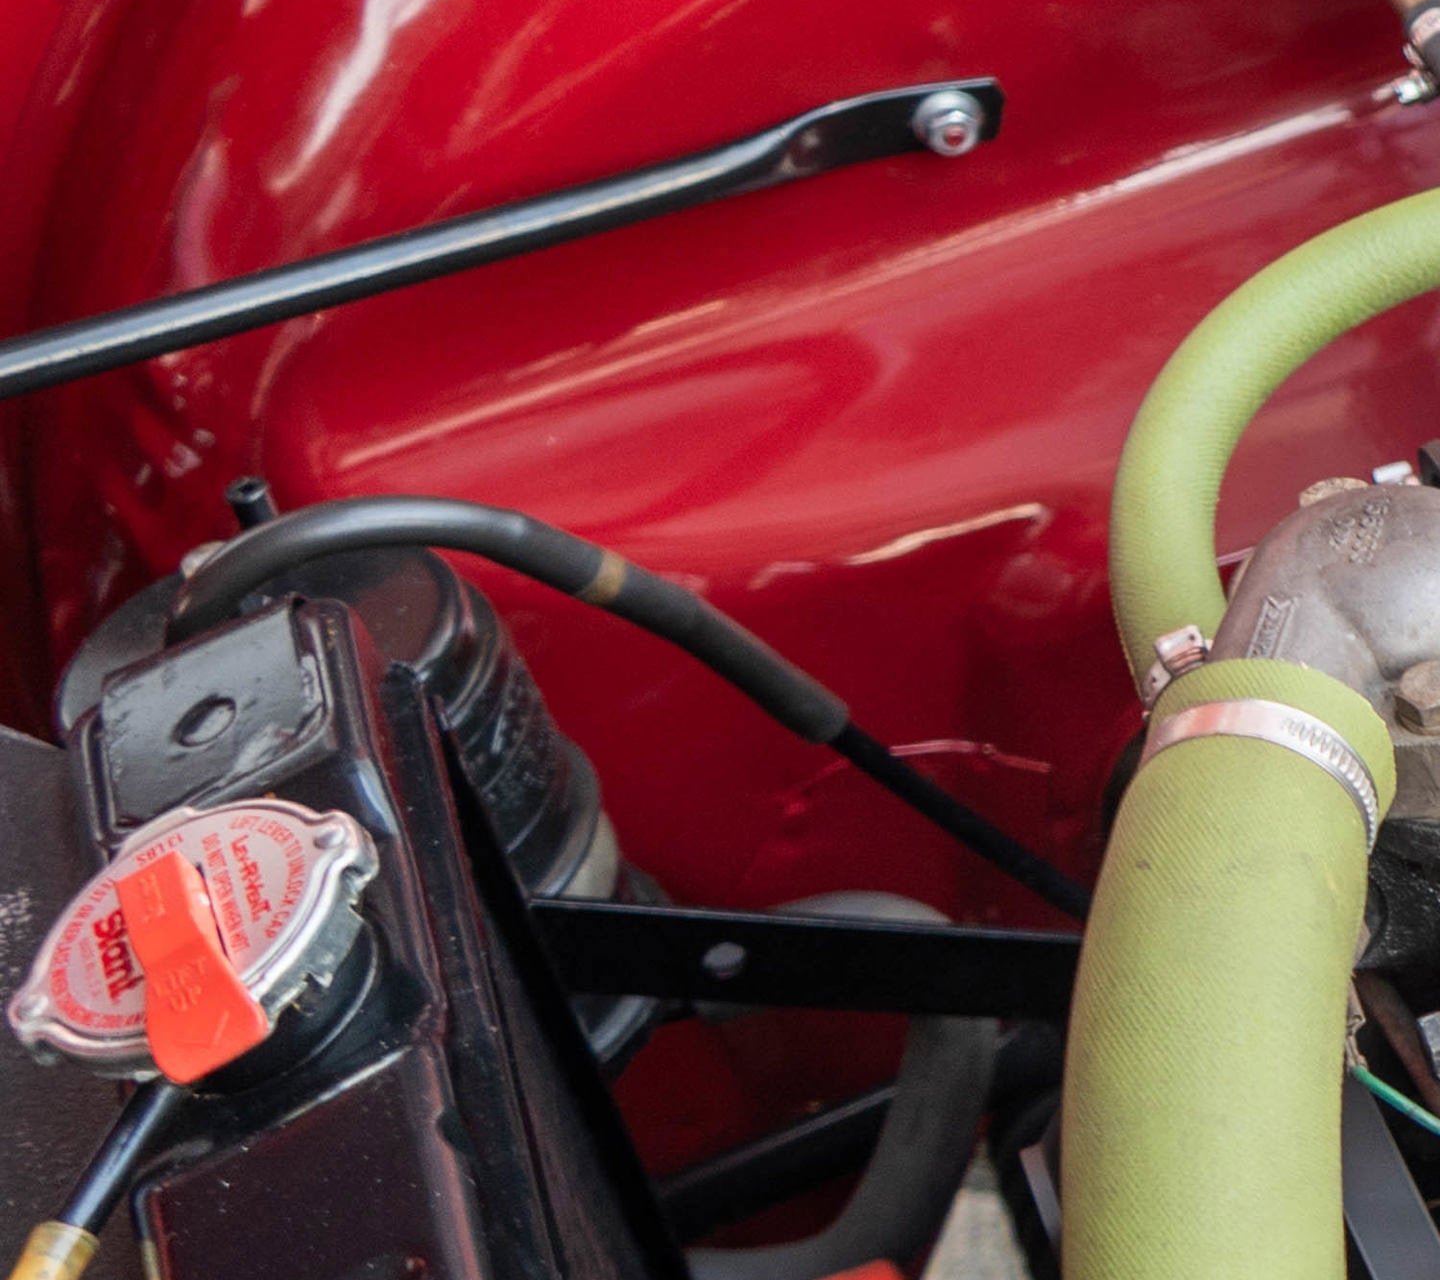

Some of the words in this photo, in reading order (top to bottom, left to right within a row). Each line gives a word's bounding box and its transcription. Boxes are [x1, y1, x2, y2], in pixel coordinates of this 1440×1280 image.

[207, 849, 228, 868] NOT
[212, 870, 234, 902] OPEN
[221, 900, 242, 933] WHEN
[264, 910, 290, 939] CAP
